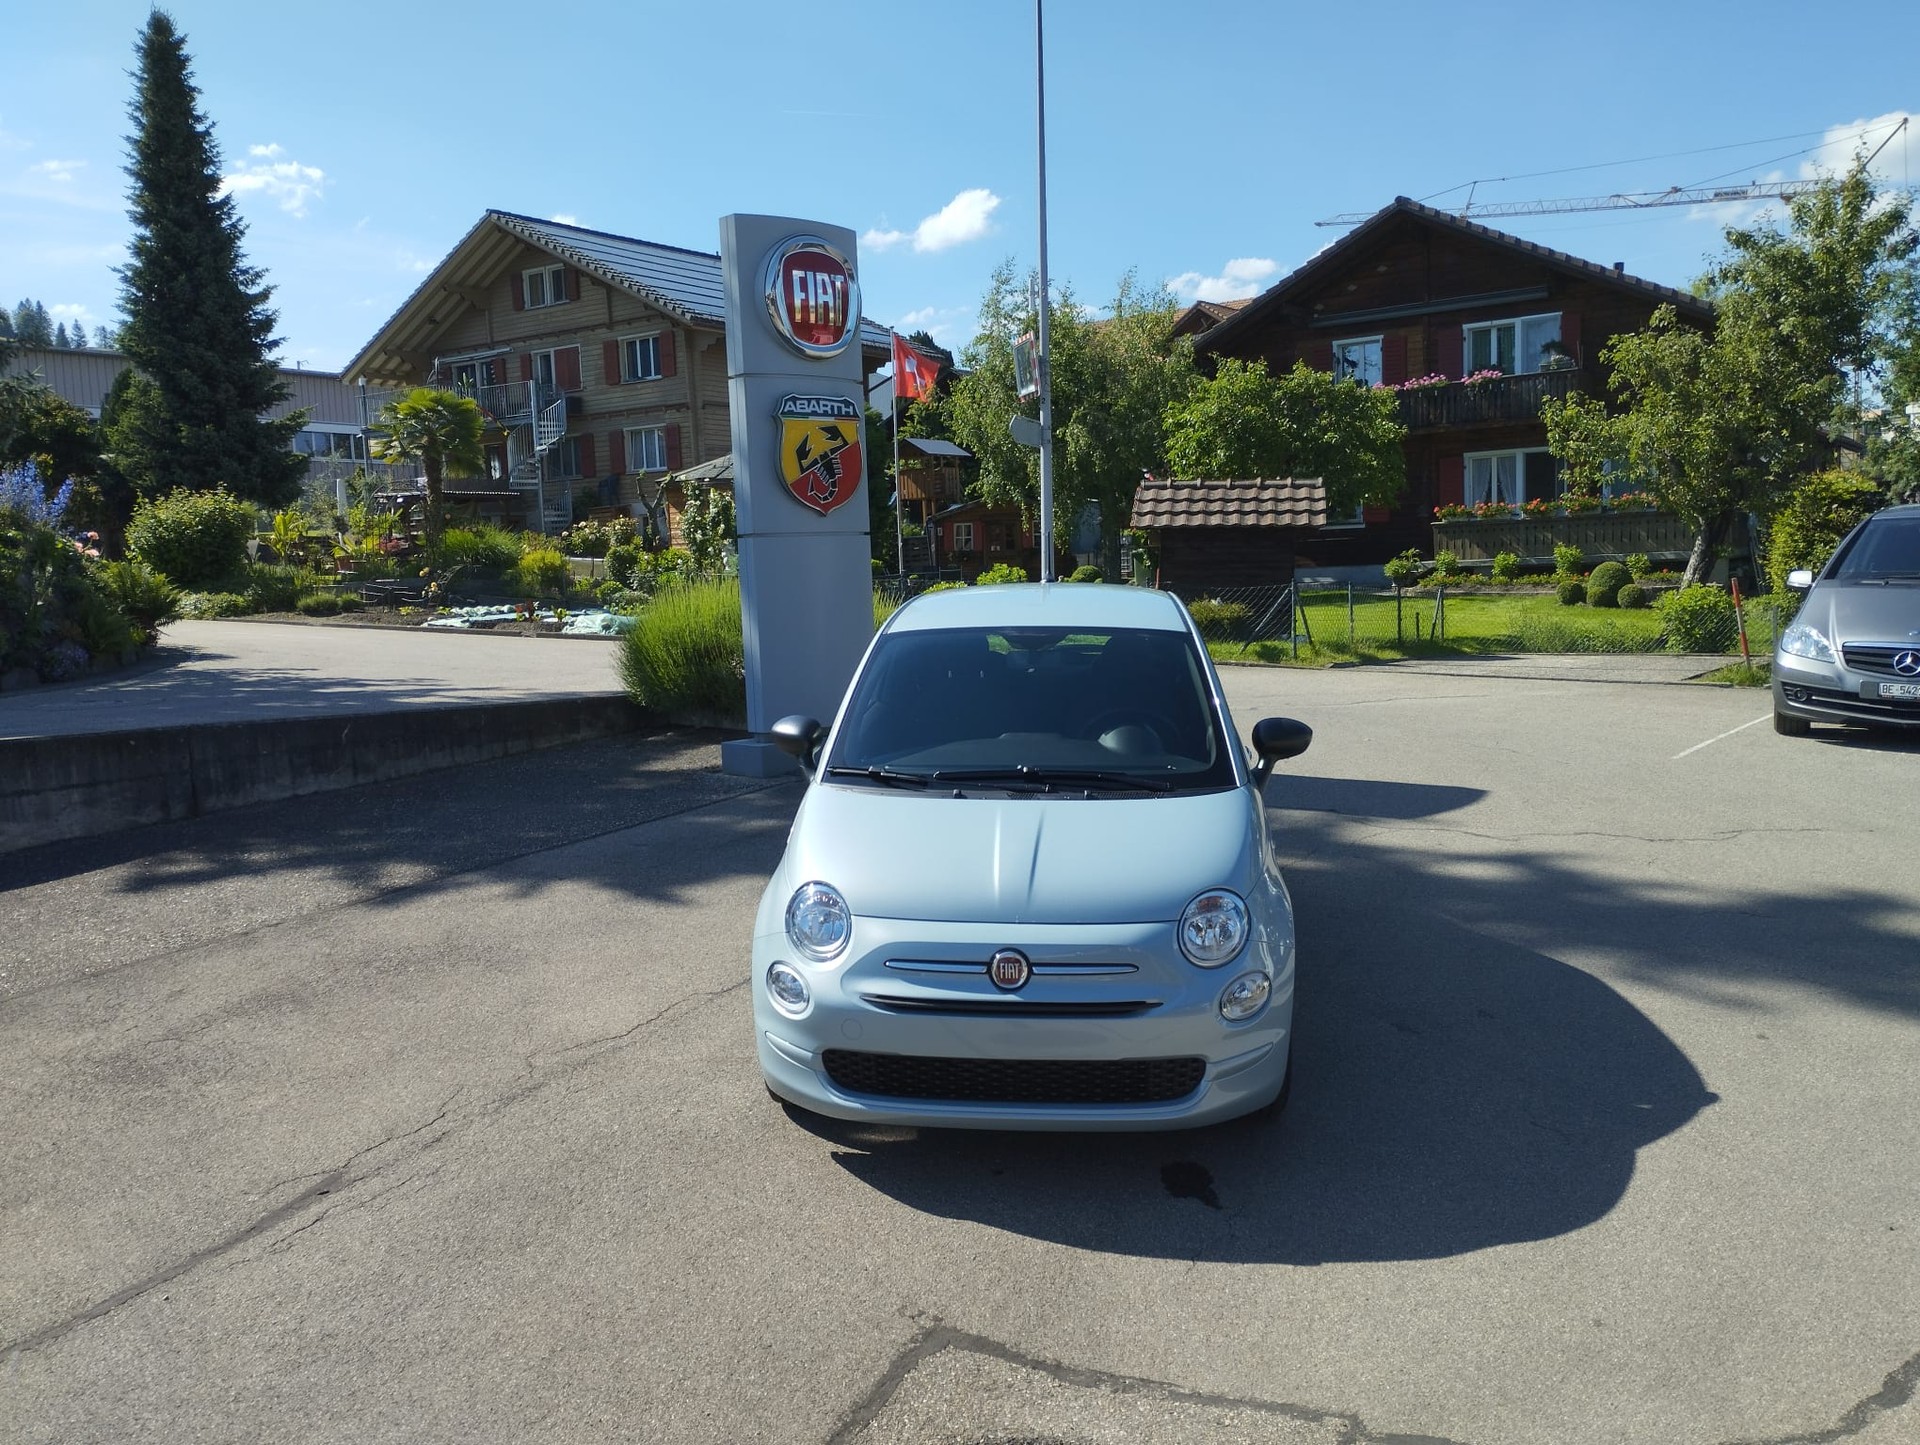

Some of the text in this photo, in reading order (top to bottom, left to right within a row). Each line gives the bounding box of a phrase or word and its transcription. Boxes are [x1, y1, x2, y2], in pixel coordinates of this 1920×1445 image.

[792, 270, 844, 326] FIAT
[784, 400, 853, 415] ABARTH
[1000, 962, 1020, 979] FIAT
